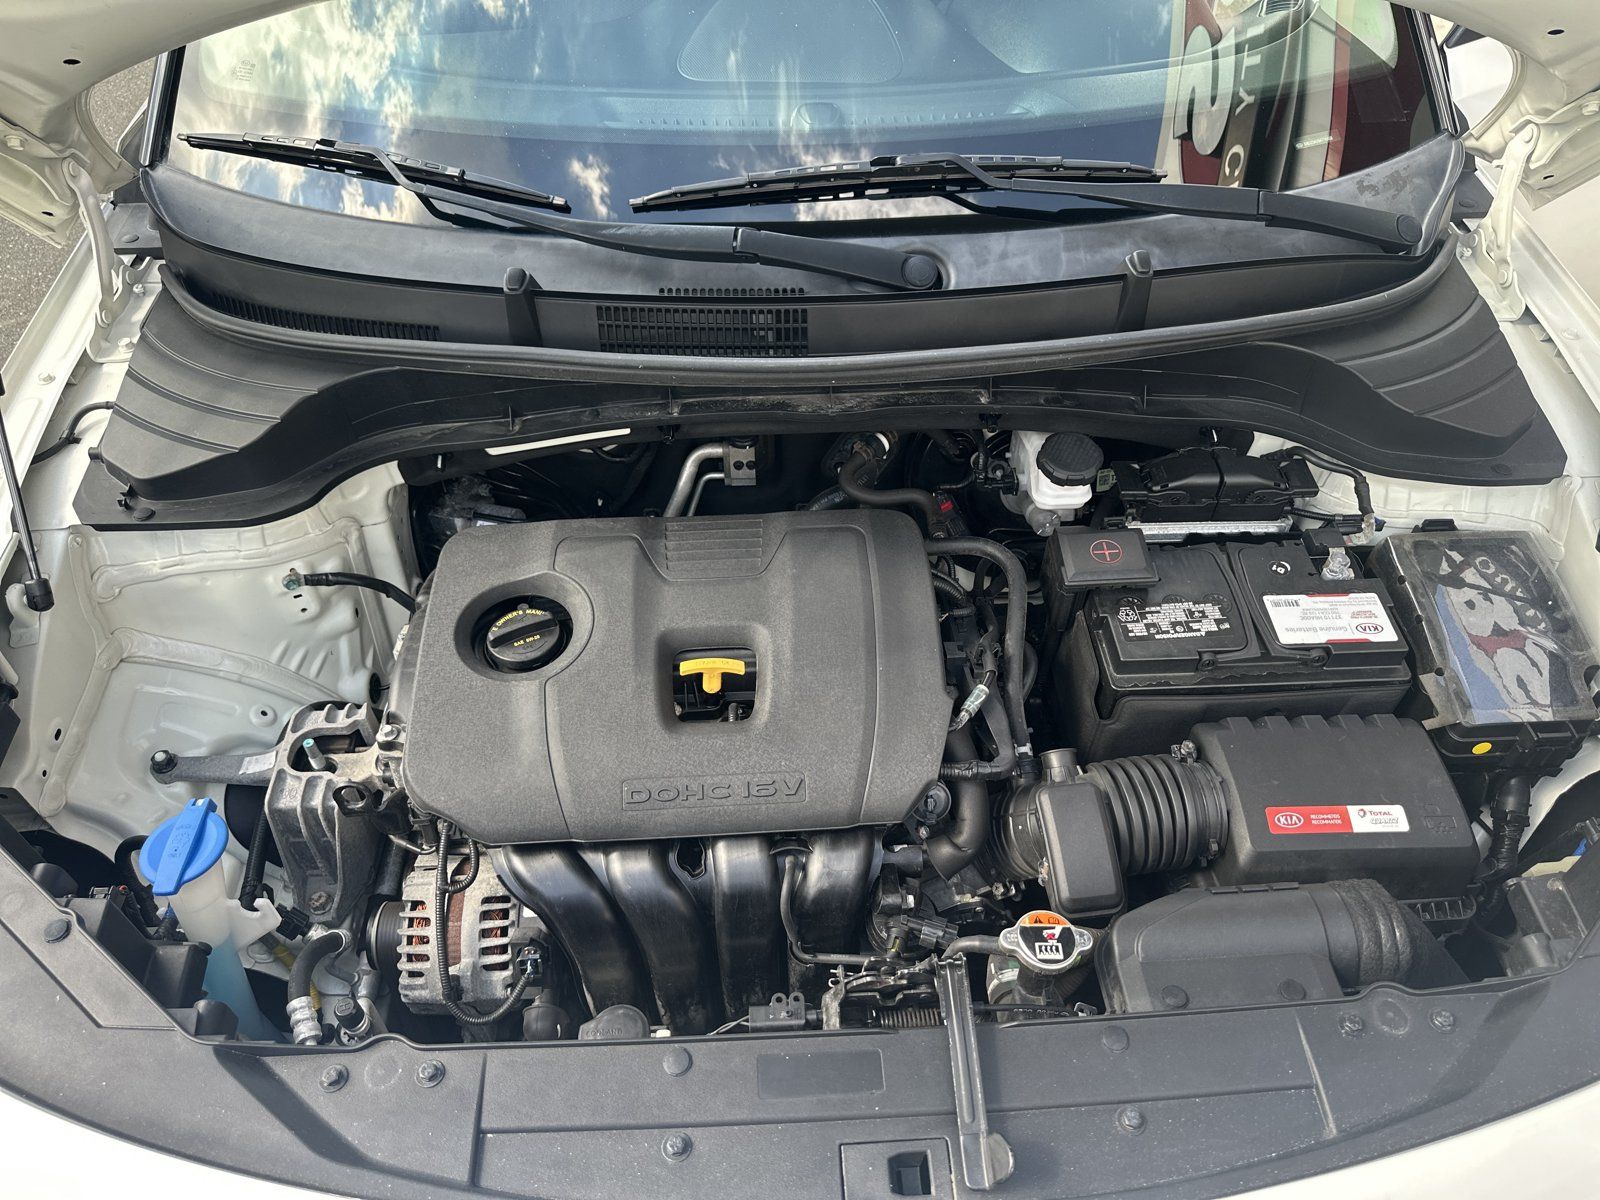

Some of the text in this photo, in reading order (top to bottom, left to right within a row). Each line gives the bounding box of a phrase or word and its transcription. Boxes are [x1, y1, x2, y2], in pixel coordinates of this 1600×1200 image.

[1359, 625, 1381, 633] KIA
[513, 639, 525, 647] SAE
[625, 784, 731, 804] DOHC
[1278, 814, 1300, 826] KIA
